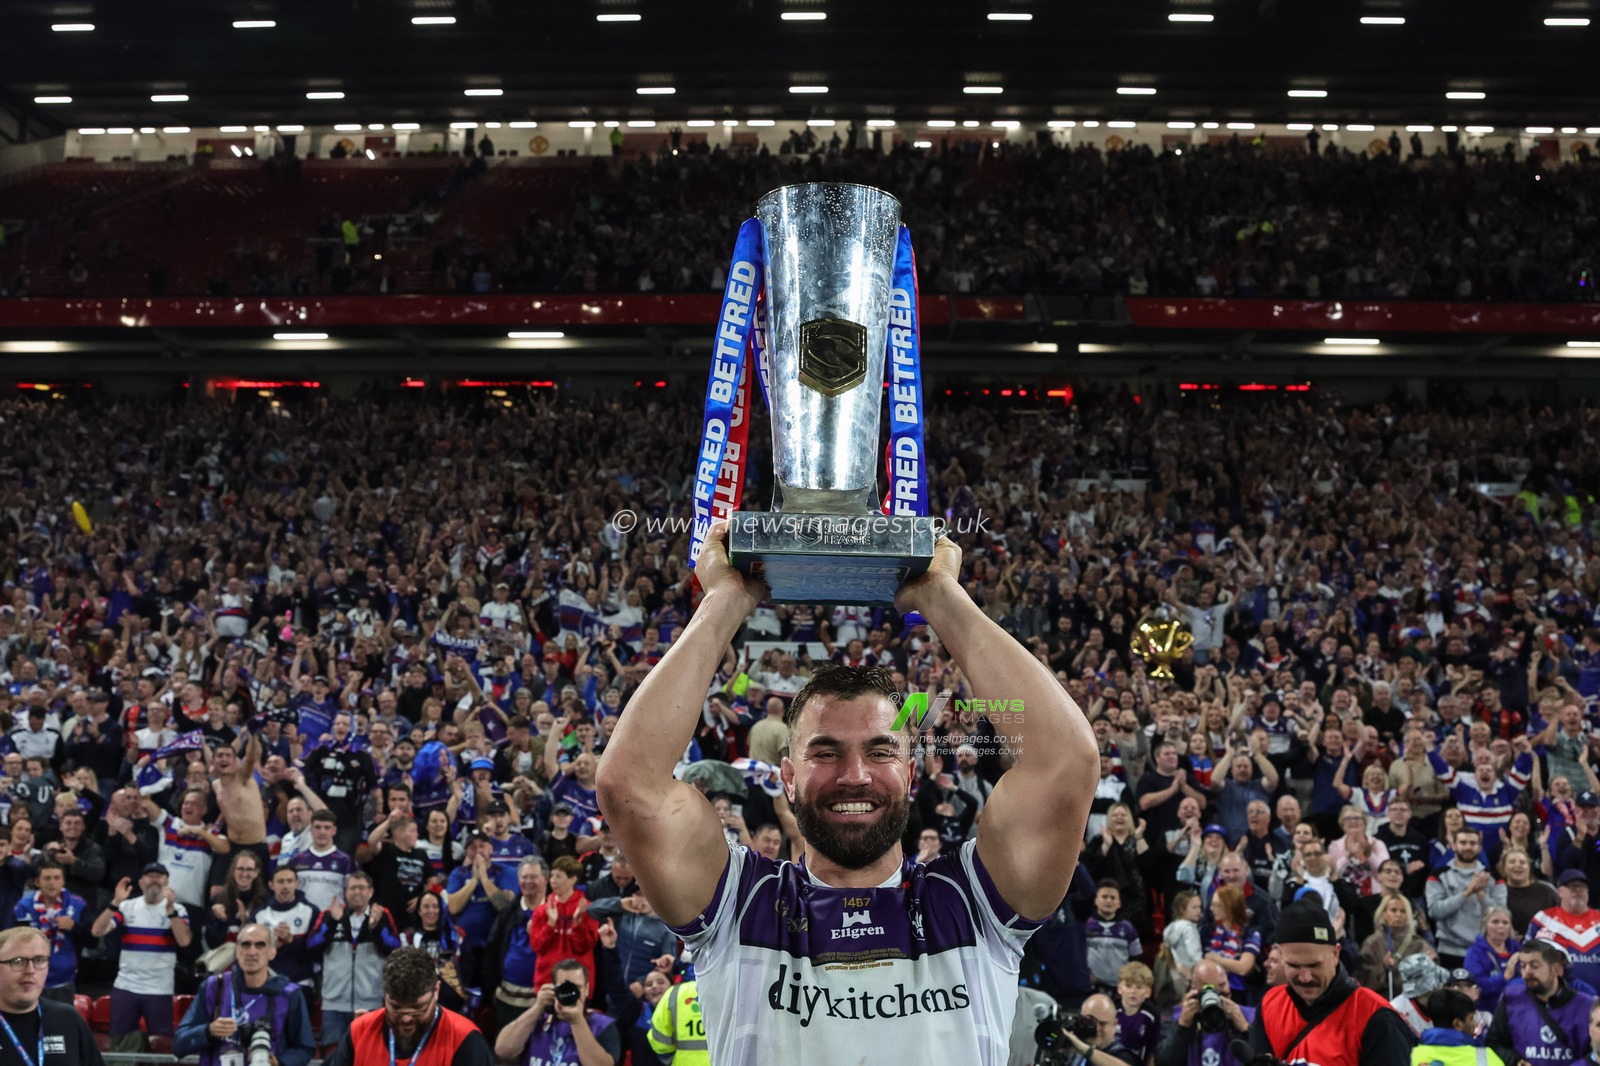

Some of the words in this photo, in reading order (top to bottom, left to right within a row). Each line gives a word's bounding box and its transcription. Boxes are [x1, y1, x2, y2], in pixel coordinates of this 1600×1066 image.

[710, 260, 756, 404] BETFRED
[889, 288, 918, 424] BETFRED
[691, 418, 726, 562] BETFRED
[894, 436, 919, 516] FRED
[830, 925, 885, 939] Ellgren
